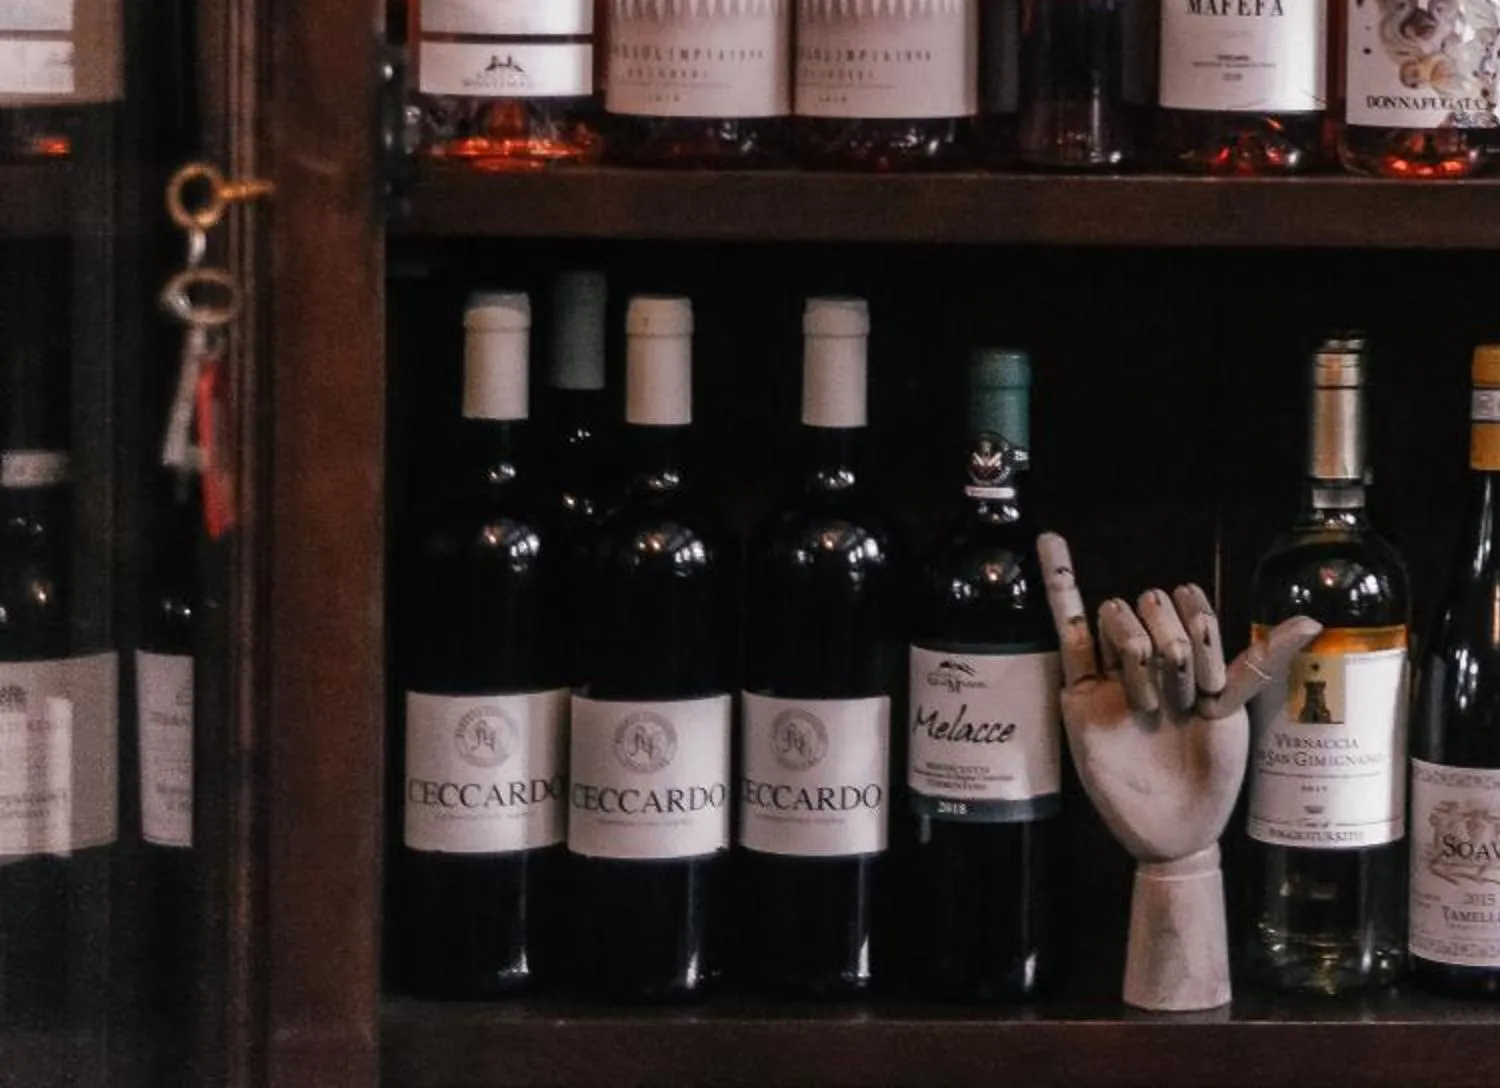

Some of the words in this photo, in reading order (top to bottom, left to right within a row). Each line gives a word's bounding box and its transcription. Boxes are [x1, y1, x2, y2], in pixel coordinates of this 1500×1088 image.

[912, 703, 1018, 745] Melacce
[408, 775, 563, 810] CECCARDO
[572, 782, 726, 814] CECCARDO
[742, 778, 883, 811] ECCARDO
